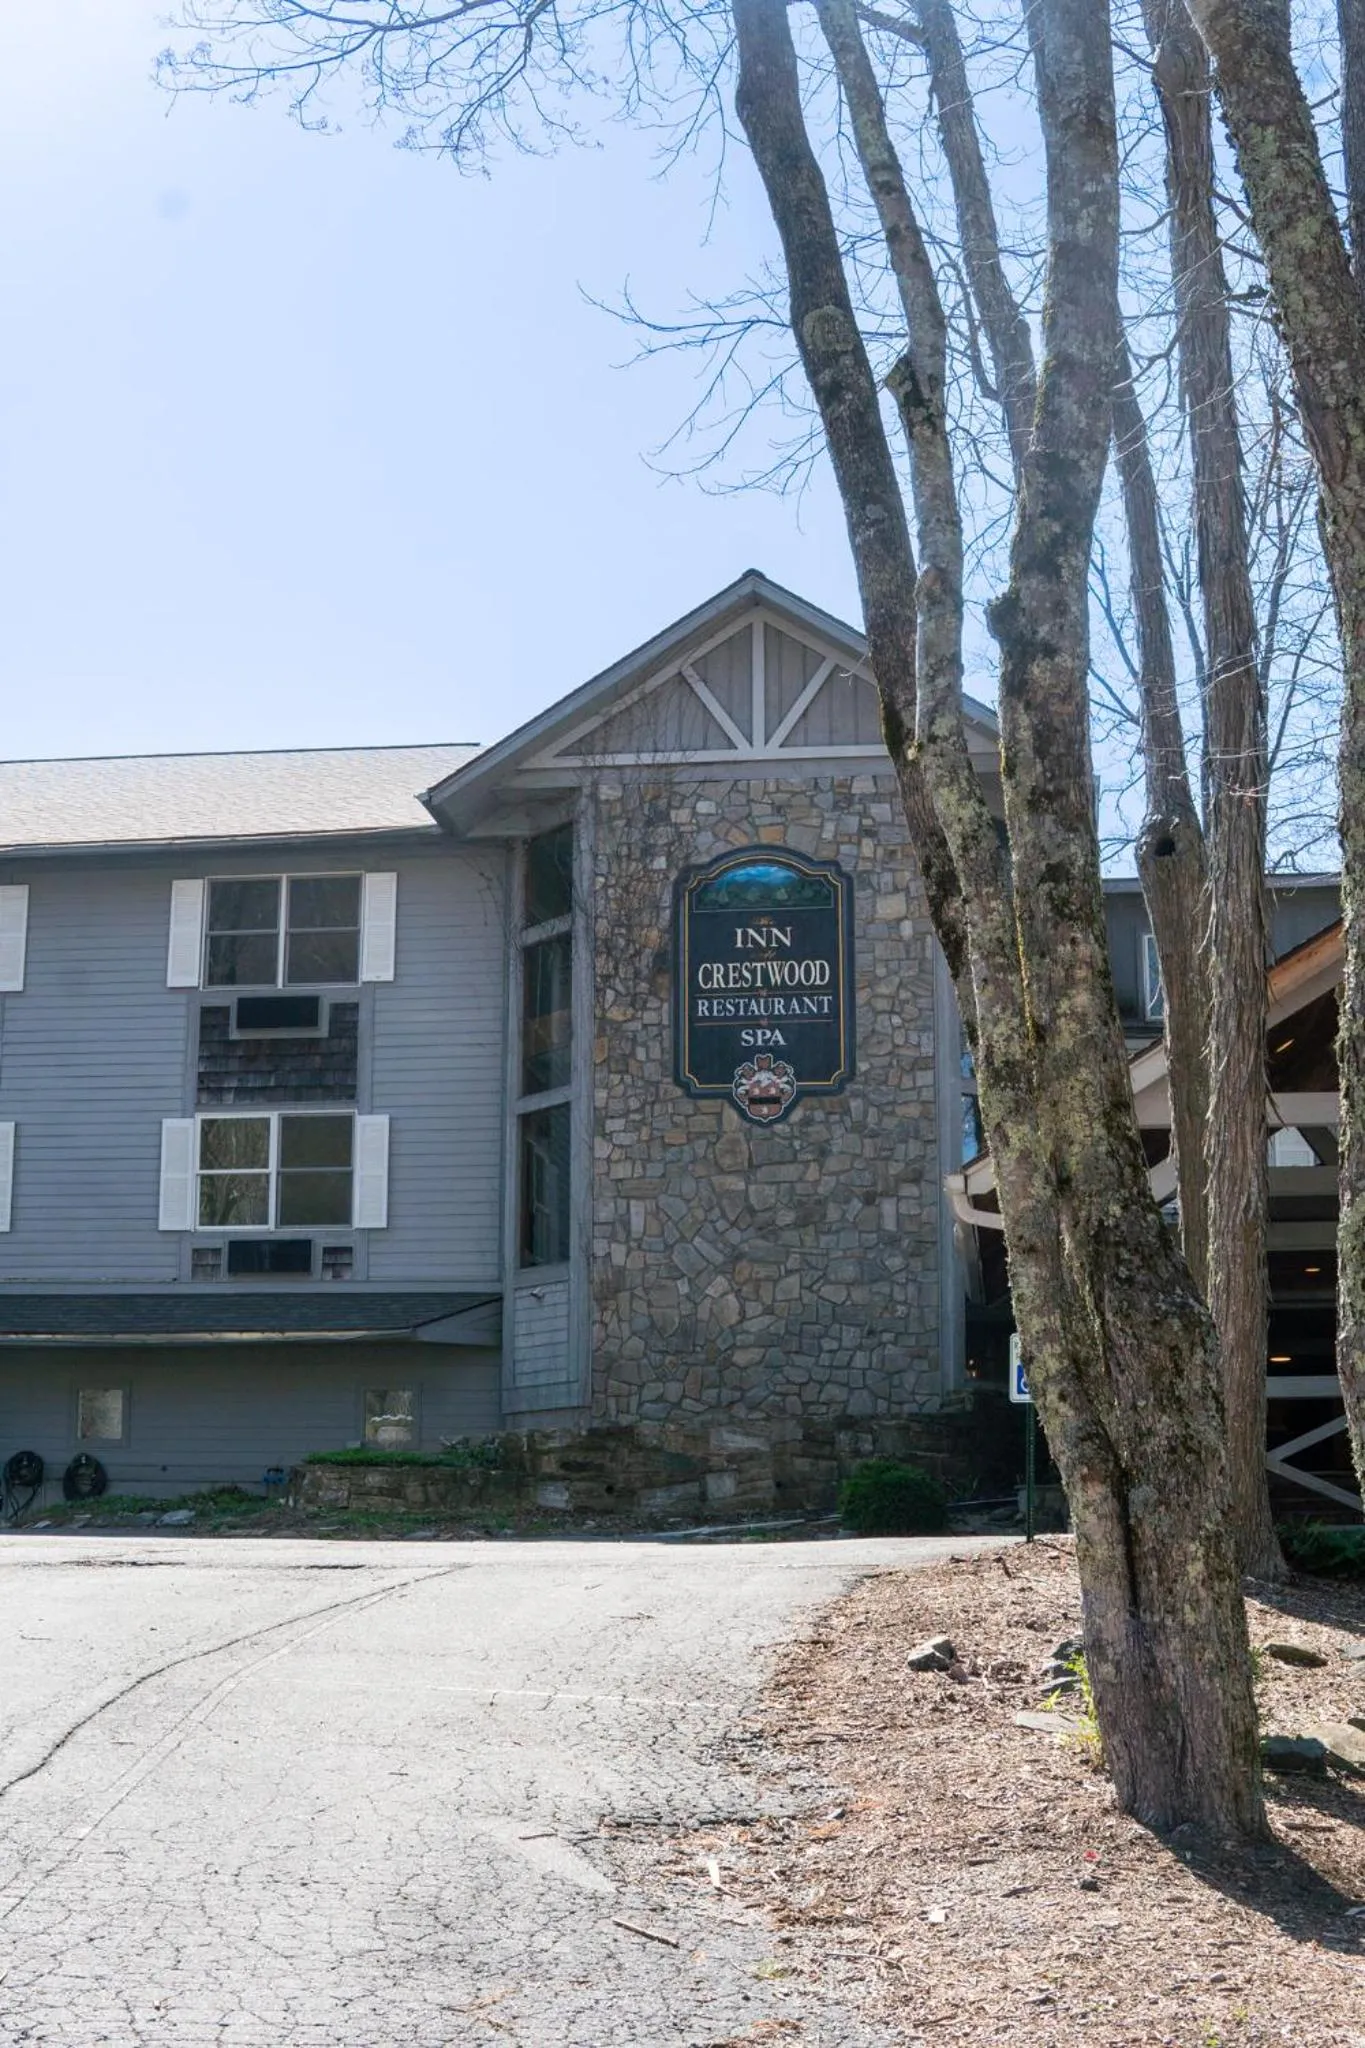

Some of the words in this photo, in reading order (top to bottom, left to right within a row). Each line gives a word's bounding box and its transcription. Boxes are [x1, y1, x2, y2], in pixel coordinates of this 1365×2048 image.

[734, 926, 793, 948] INN
[698, 960, 830, 989] CRESTWOOD
[697, 996, 832, 1017] RESTAURANT
[740, 1028, 787, 1047] SPA
